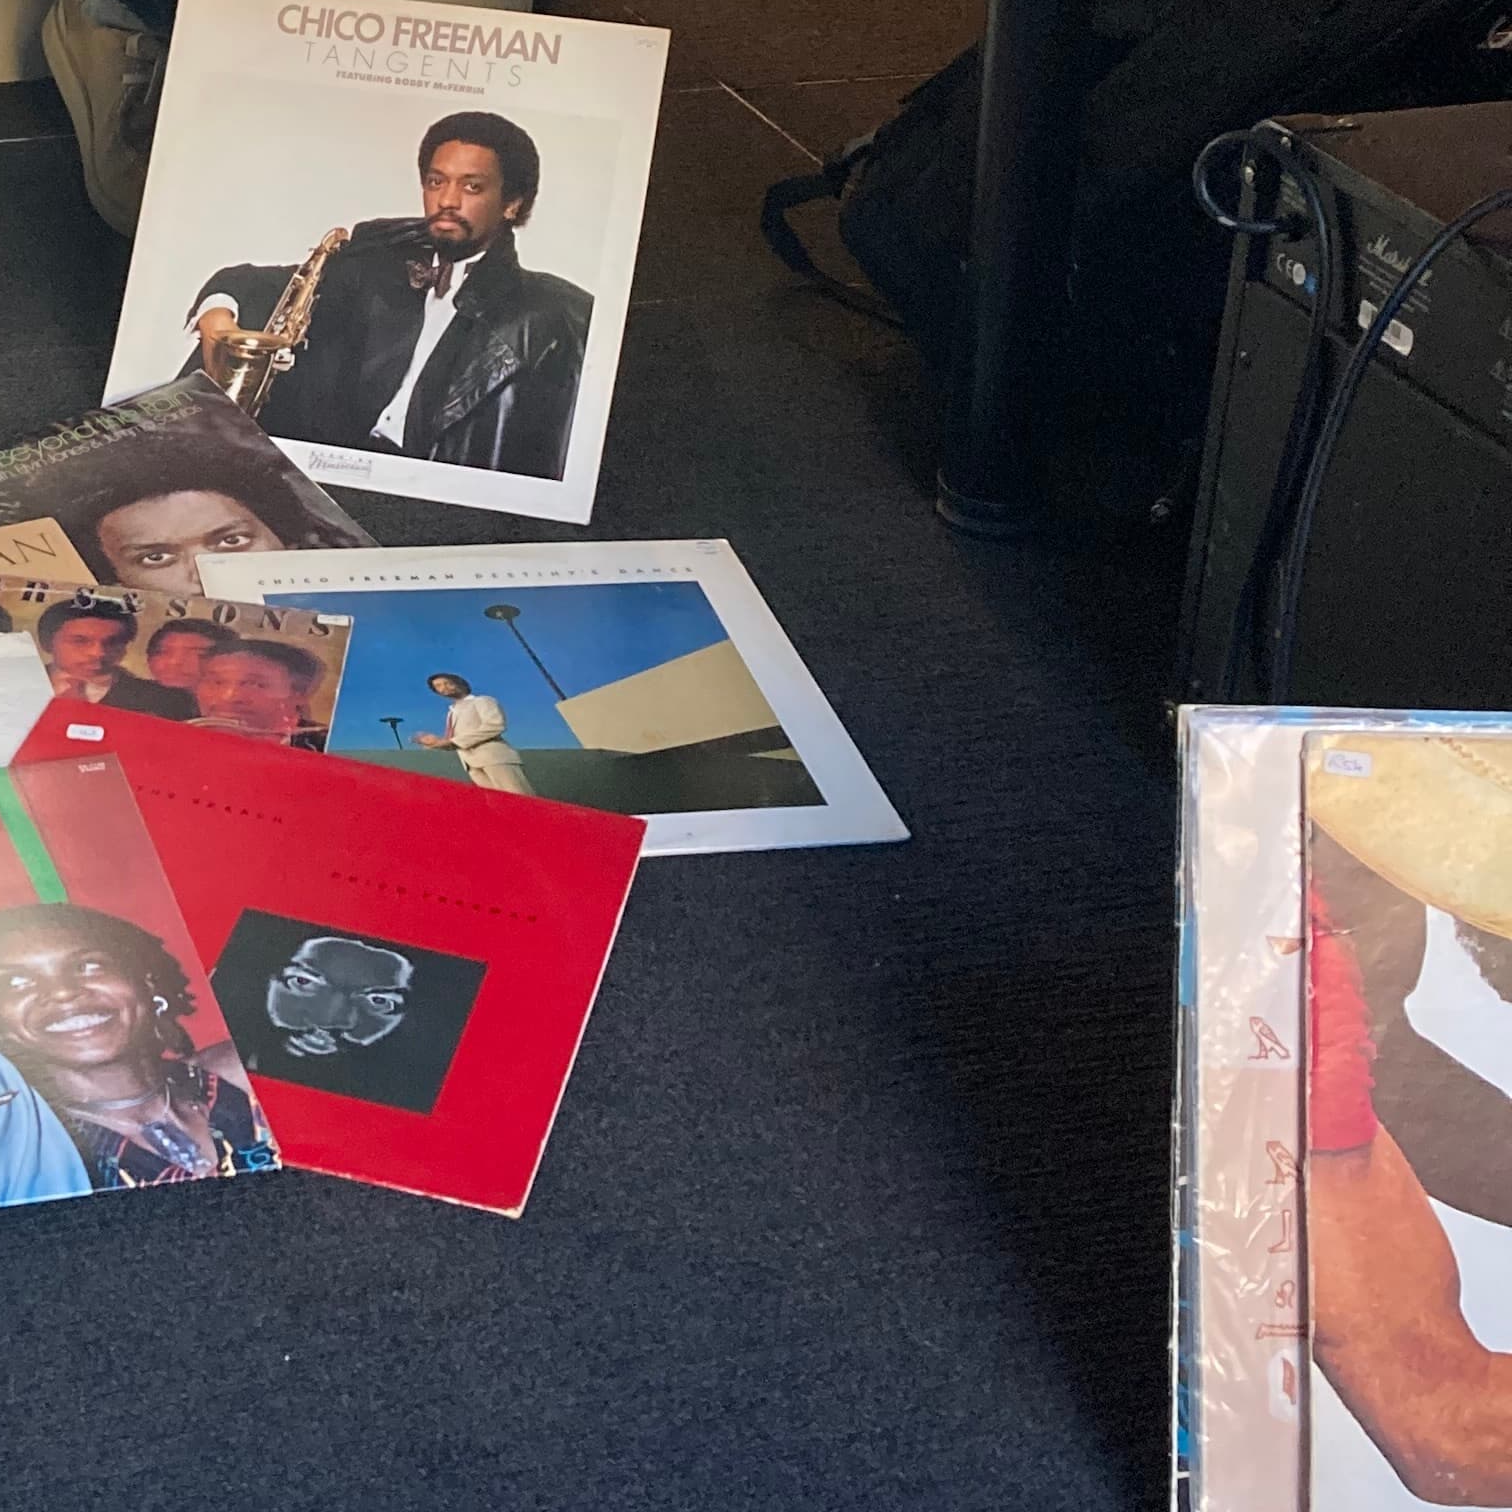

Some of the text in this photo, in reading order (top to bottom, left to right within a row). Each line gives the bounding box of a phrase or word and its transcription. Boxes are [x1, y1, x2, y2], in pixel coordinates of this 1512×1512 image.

[277, 3, 563, 65] CHICO FREEMAN
[304, 40, 523, 88] TANGENTS
[336, 69, 393, 86] FEATURING
[394, 75, 430, 90] BOBBY
[138, 389, 195, 418] Rain
[257, 565, 693, 586] CHICO FREEMAN DESTINY'S DANCE
[165, 597, 334, 638] SONS
